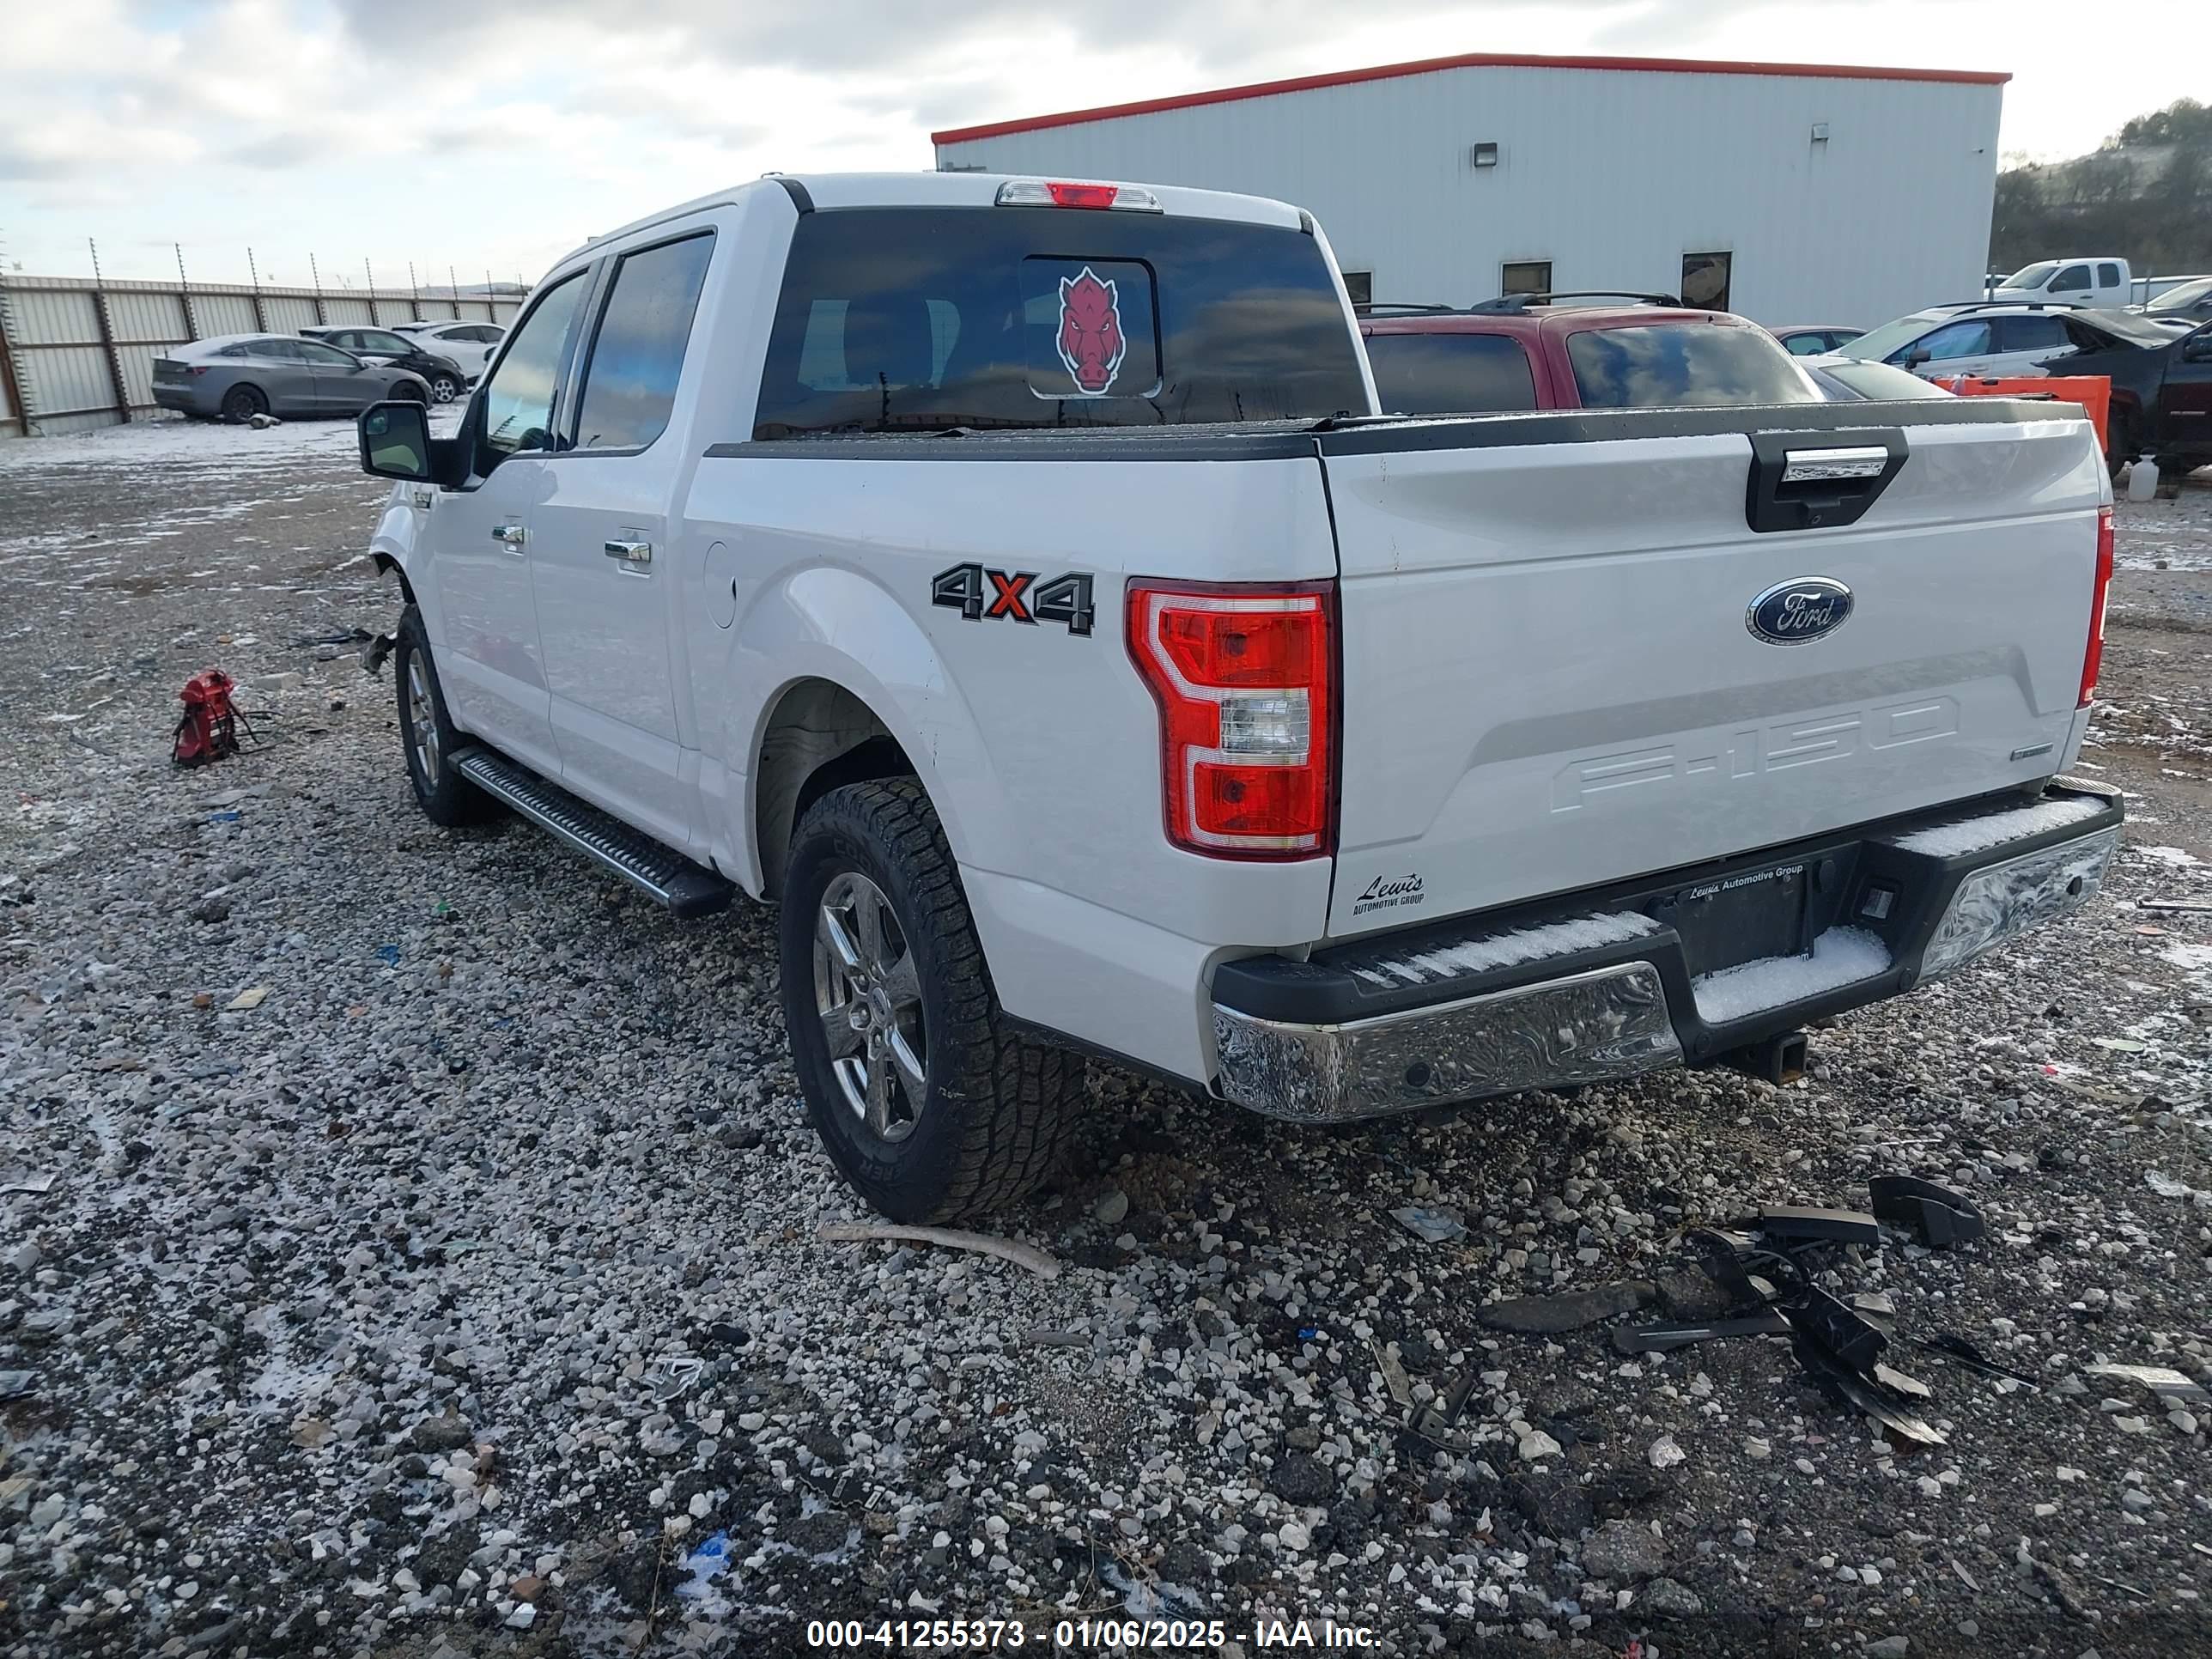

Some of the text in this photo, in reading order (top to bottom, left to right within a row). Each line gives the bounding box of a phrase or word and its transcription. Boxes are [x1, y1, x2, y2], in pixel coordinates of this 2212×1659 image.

[1777, 592, 1834, 631] Ford
[1550, 694, 1960, 814] F-150
[1356, 874, 1425, 902] Lewis
[1690, 864, 1803, 900] Lewis Automotive Group
[1352, 892, 1425, 917] AUTOMOTIVE GROUP
